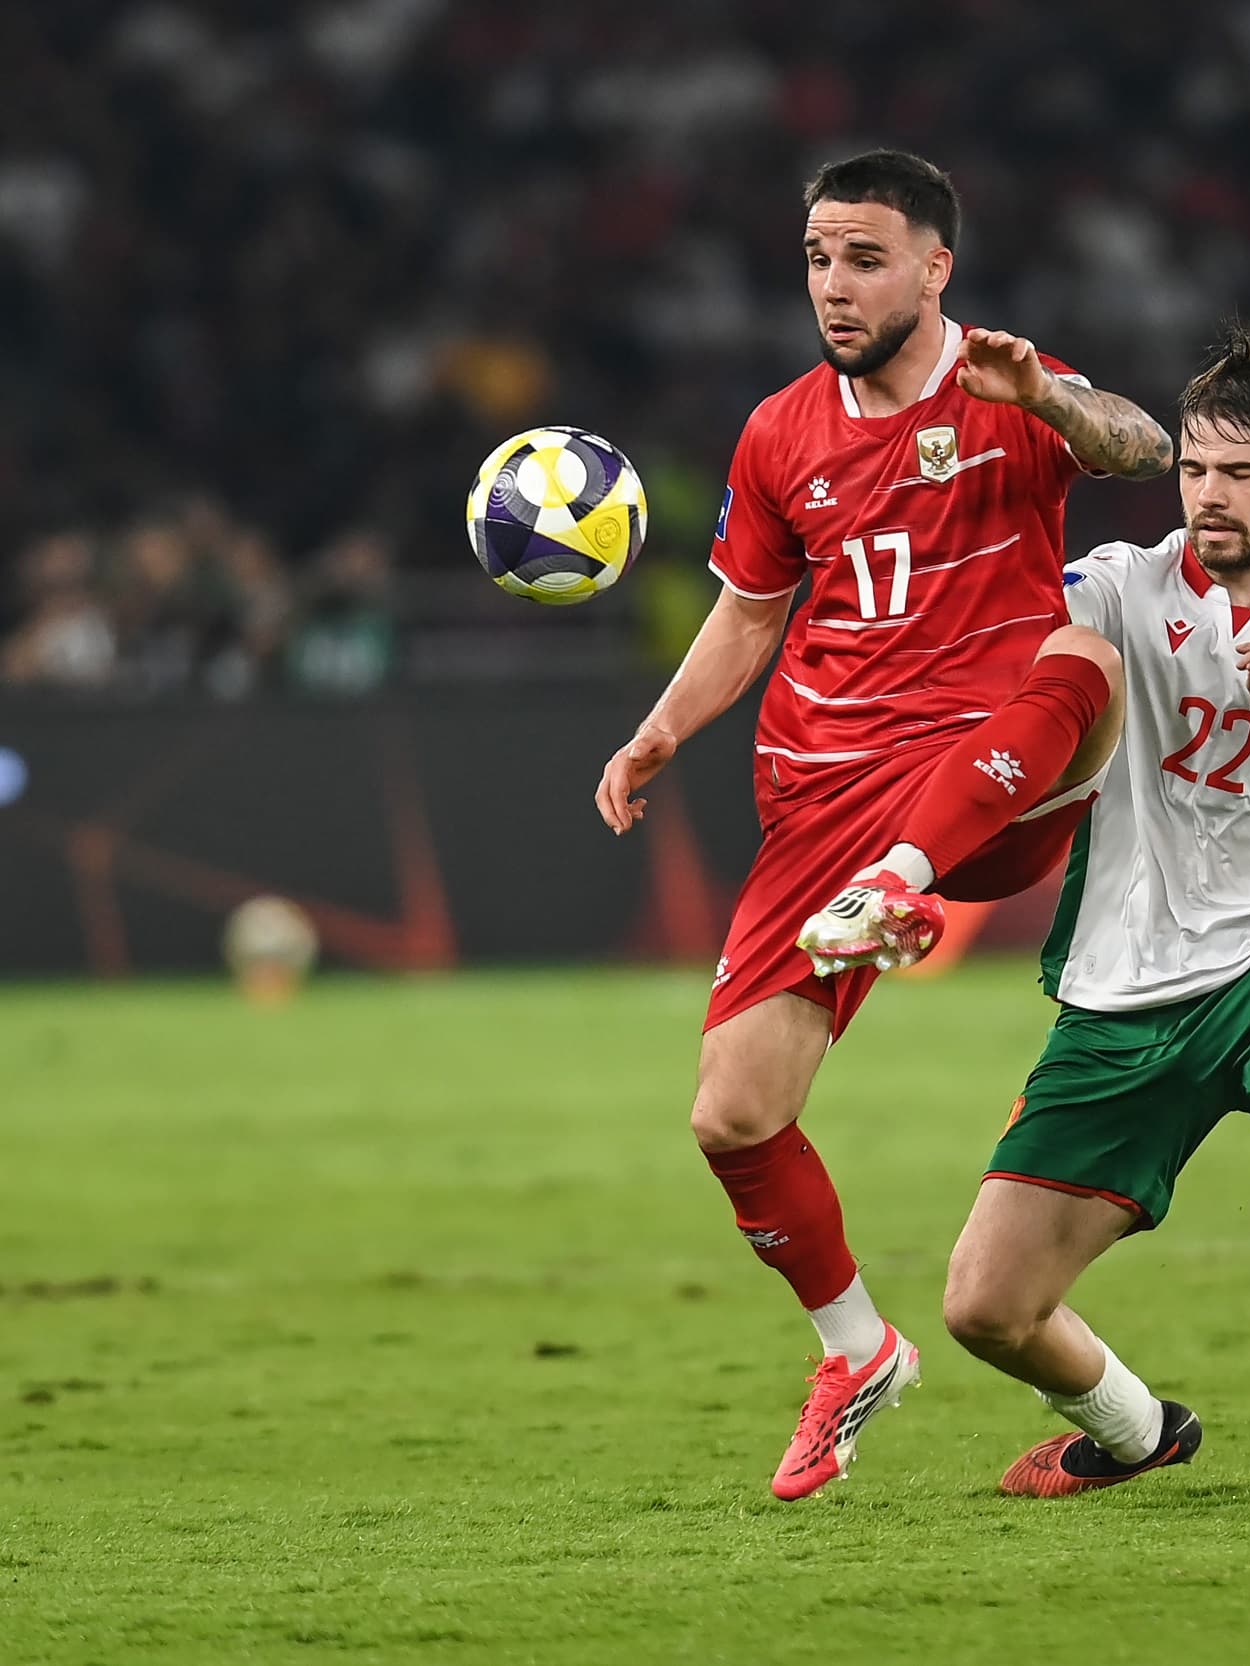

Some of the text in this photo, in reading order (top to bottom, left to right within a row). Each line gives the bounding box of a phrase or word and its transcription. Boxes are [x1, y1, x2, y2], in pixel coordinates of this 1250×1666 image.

[804, 497, 839, 510] KELME
[842, 531, 911, 619] 17
[972, 758, 1017, 796] KELME
